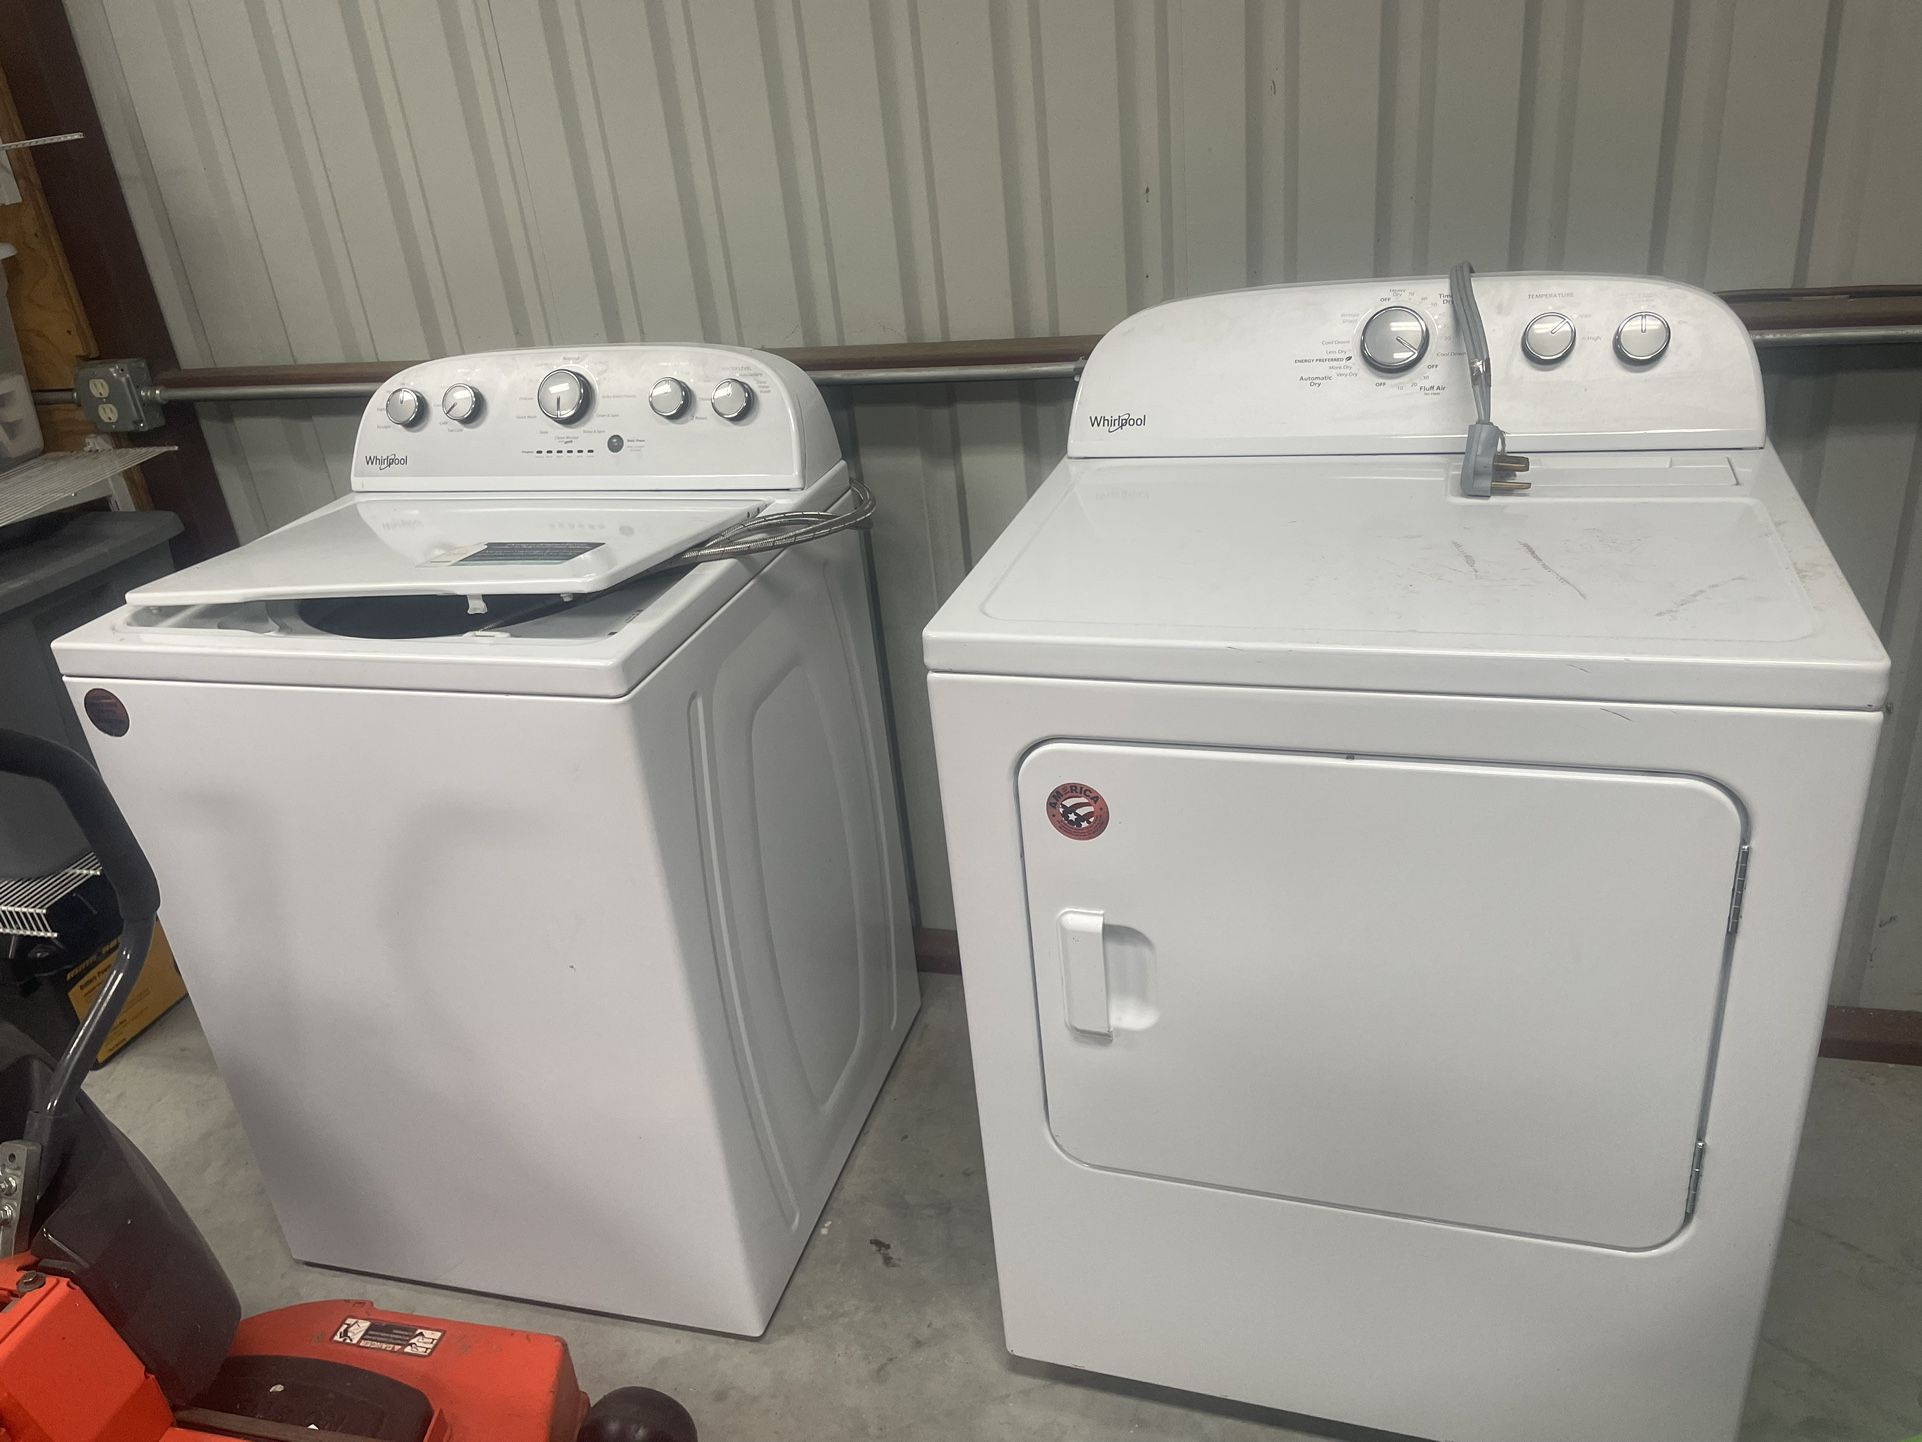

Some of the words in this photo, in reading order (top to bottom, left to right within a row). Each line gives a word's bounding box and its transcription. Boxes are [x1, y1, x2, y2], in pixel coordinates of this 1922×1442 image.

[1419, 384, 1435, 392] Fluff
[1435, 384, 1446, 392] Air
[1089, 412, 1147, 433] Whirlpool
[365, 453, 408, 470] Whirlpool
[1049, 785, 1100, 809] AMERICA
